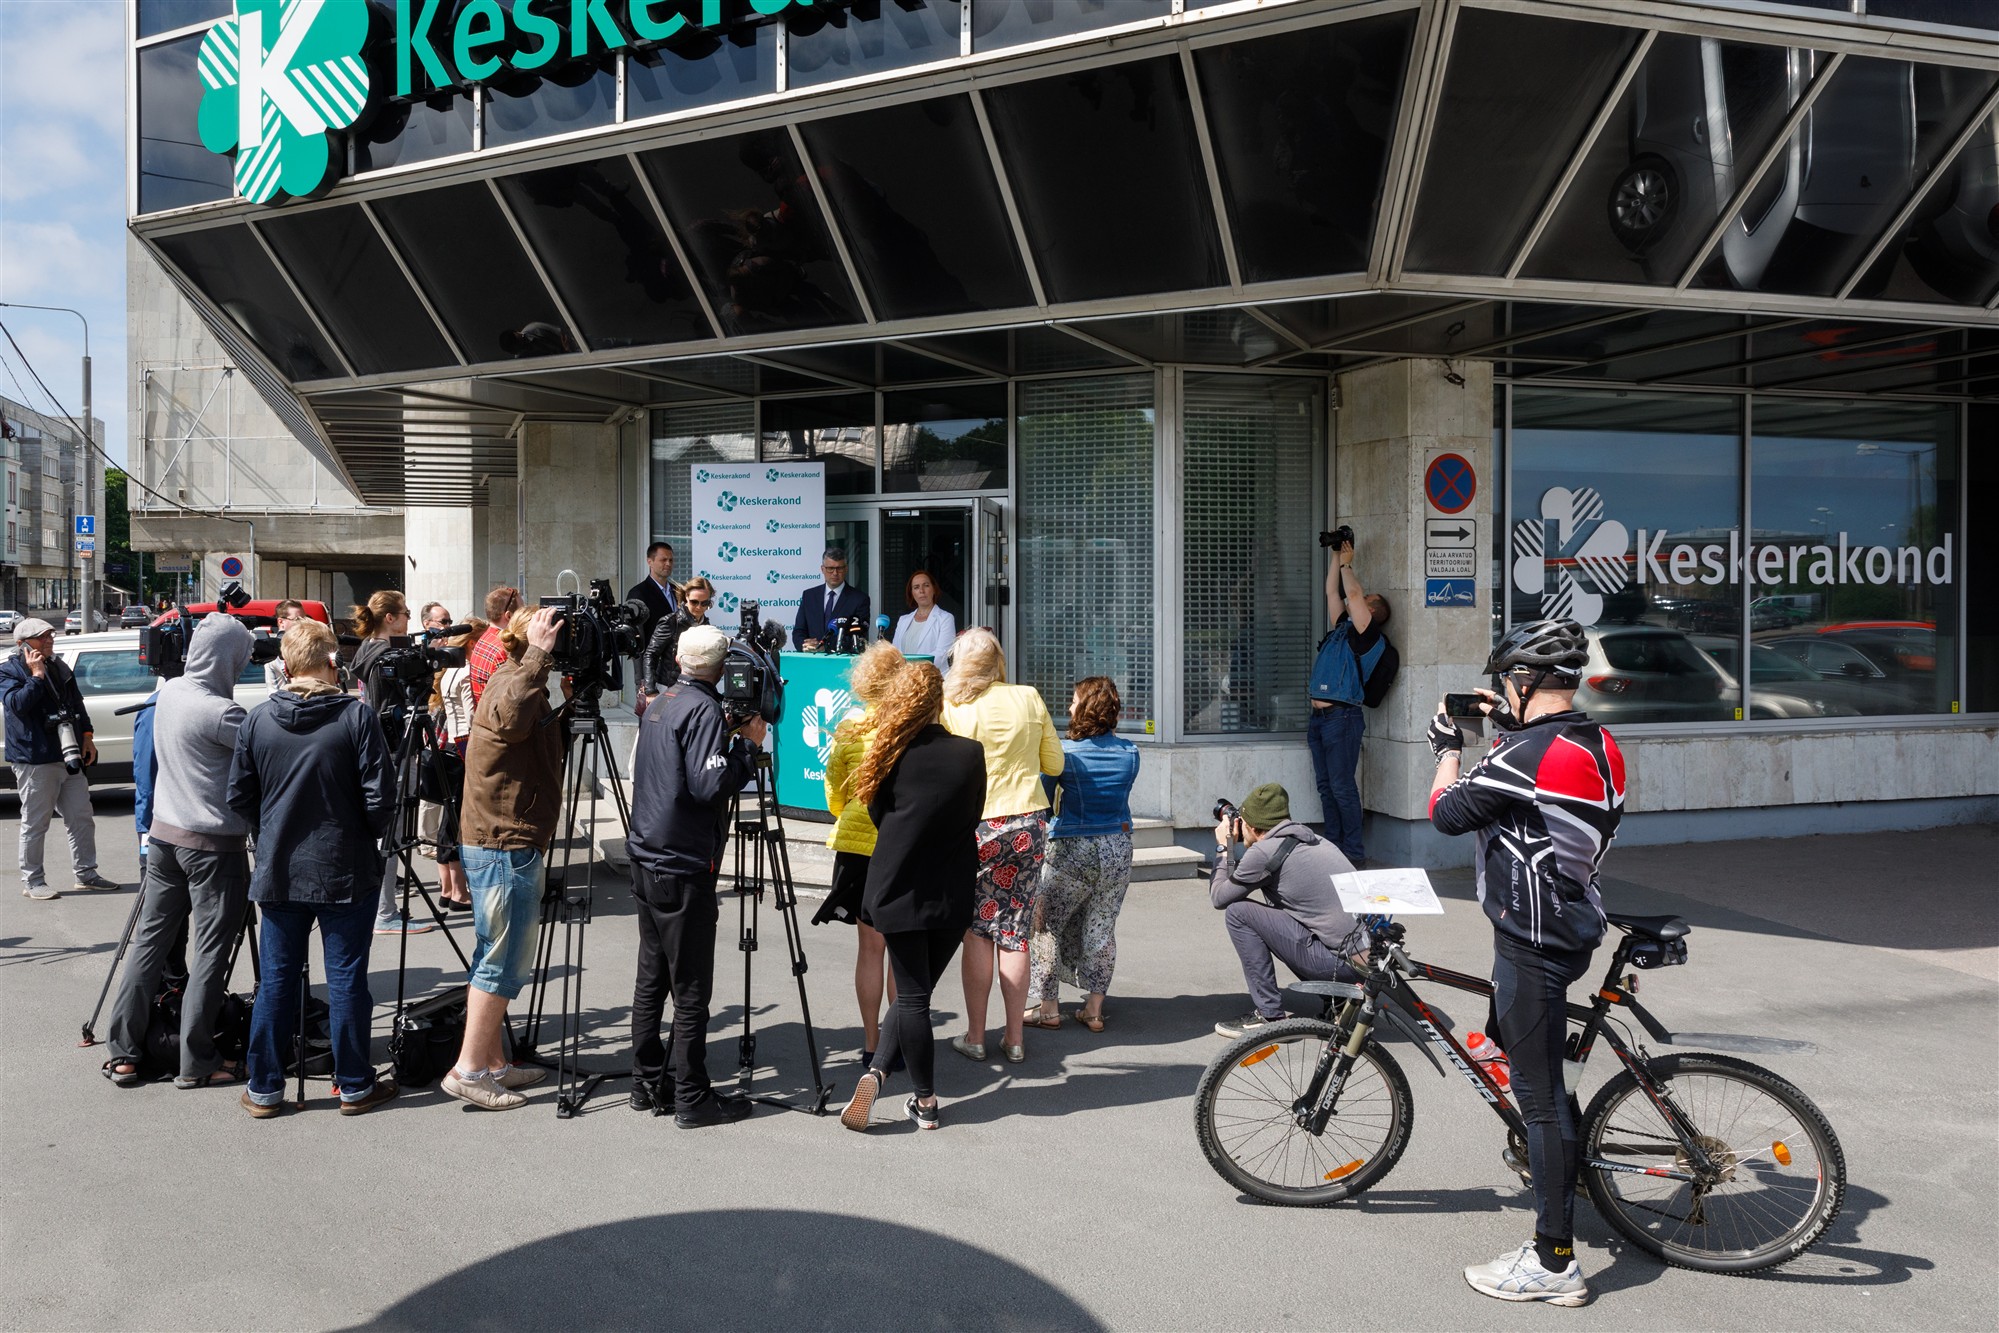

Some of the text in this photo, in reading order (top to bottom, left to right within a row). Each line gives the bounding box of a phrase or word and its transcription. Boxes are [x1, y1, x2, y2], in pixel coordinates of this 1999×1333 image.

[740, 496, 801, 506] Keskerakond
[740, 547, 802, 557] Keskerakond
[1637, 529, 1953, 586] Keskerakond
[741, 597, 803, 607] kerakond
[1416, 1019, 1499, 1103] MERIDA
[1322, 1075, 1341, 1111] DRAKE
[1398, 1091, 1409, 1123] RALPH
[1590, 1161, 1646, 1175] MERIDA
[1790, 1180, 1838, 1253] RACING RALPH
